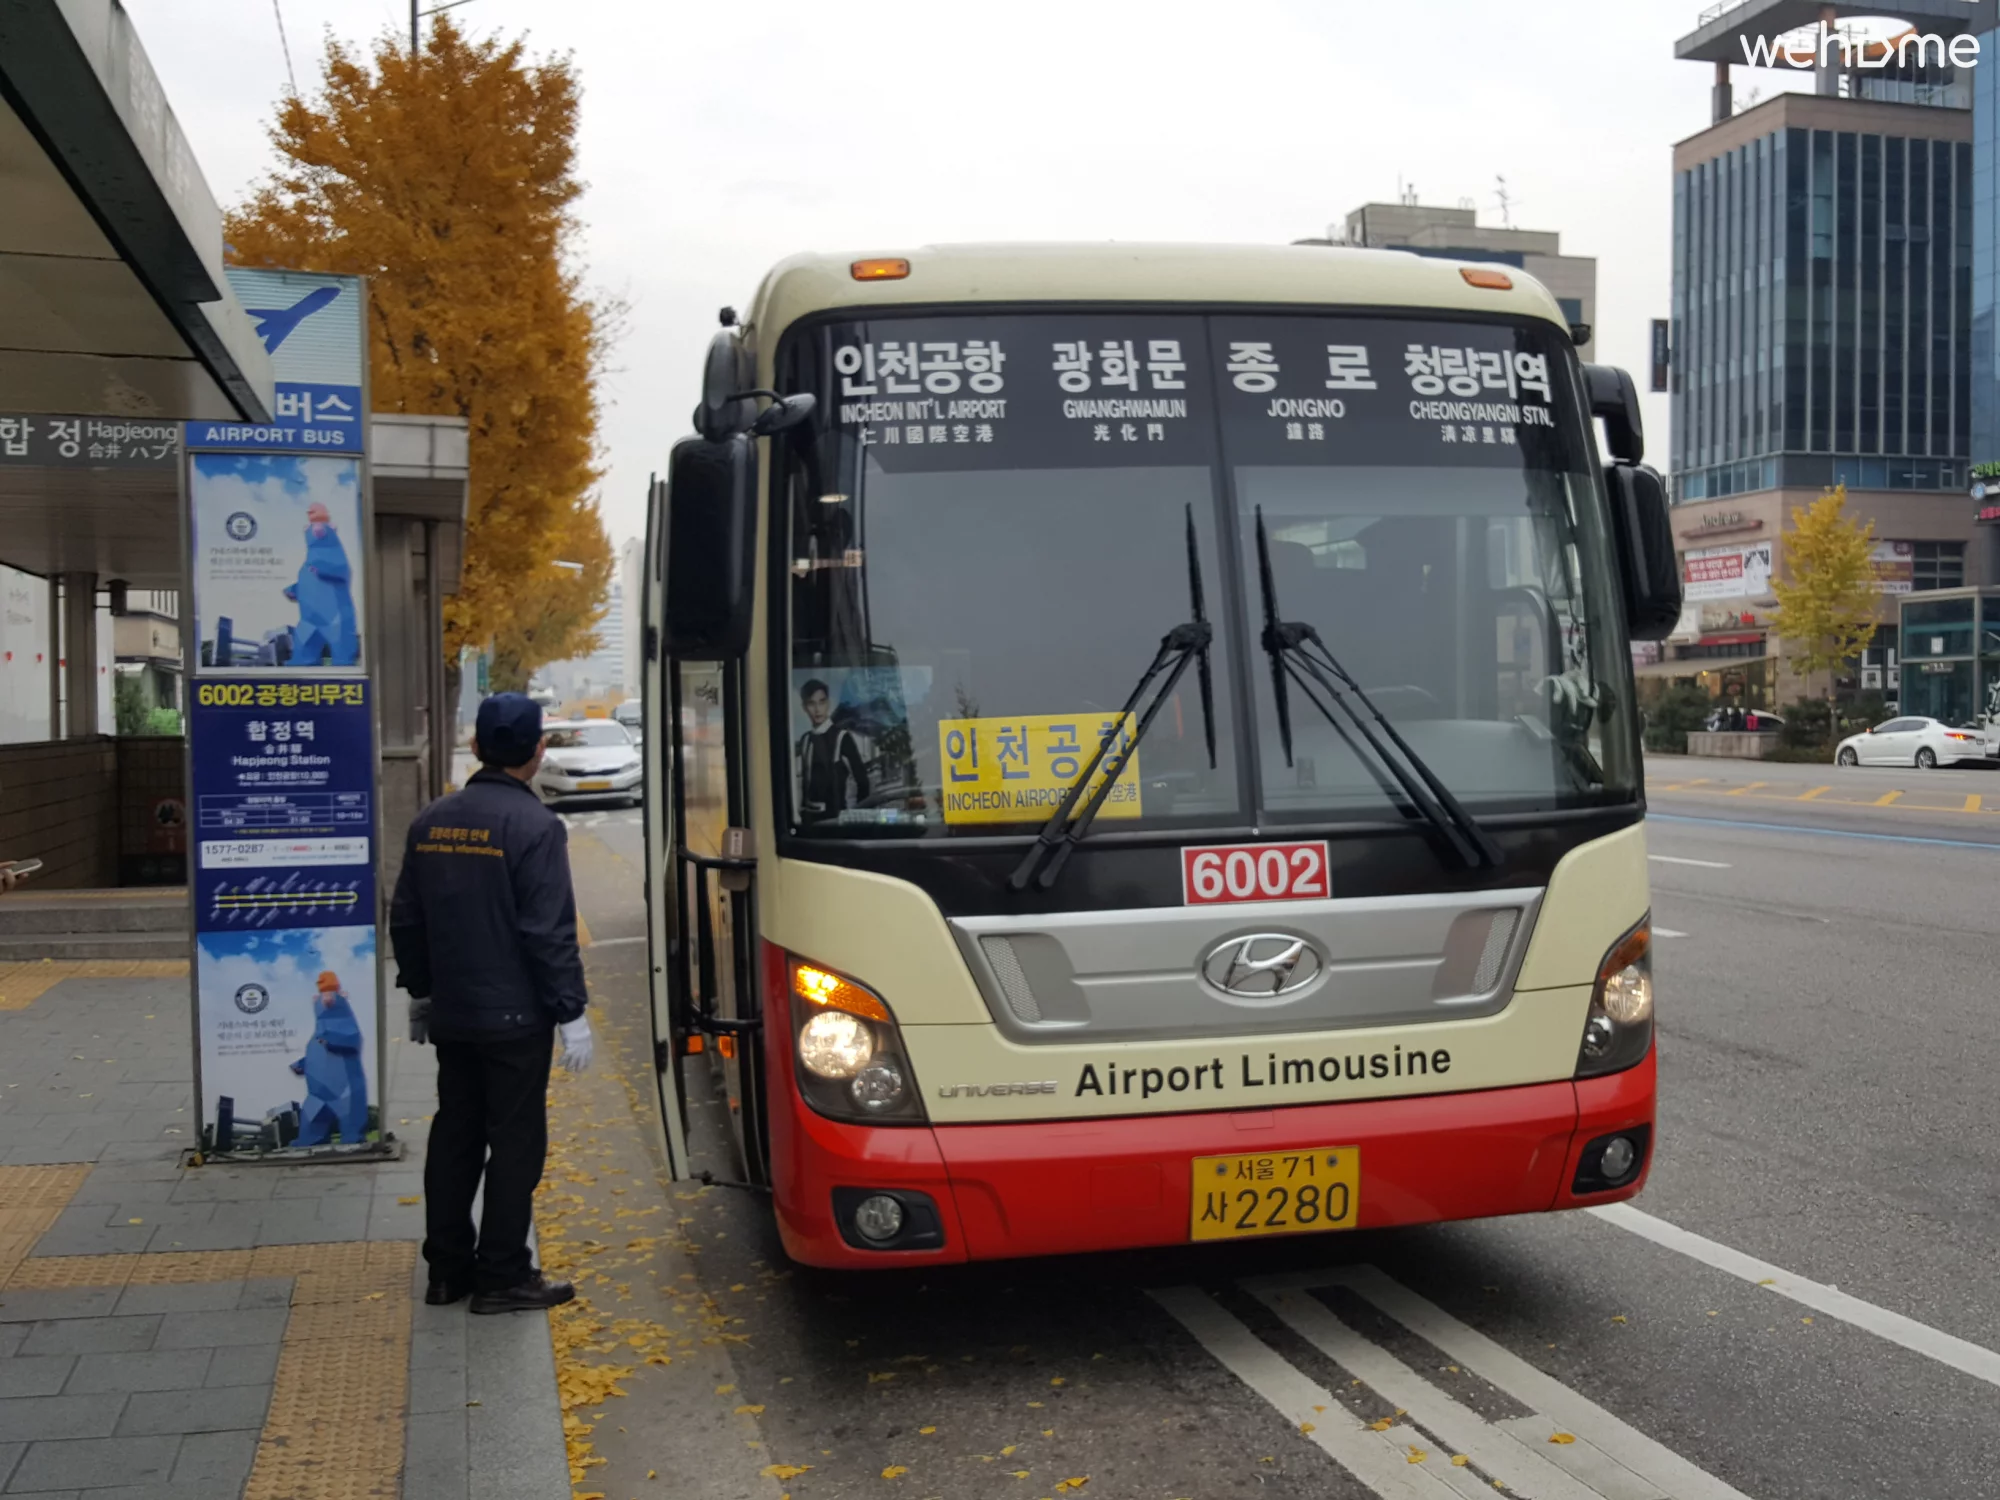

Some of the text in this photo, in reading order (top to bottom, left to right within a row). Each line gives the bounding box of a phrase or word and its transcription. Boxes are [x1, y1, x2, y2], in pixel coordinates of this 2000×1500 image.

[835, 340, 1006, 396] 인천공항
[1053, 340, 1187, 393] 광화문
[1404, 344, 1551, 402] 청량리역
[841, 402, 904, 423] INCHEON
[947, 399, 1007, 419] AIRPORT
[1063, 400, 1187, 419] GWANGHWAMUN
[1267, 398, 1345, 418] JONGNO
[1409, 400, 1554, 428] CHEONGYANGNI STN.
[87, 420, 178, 445] Hapjeong
[206, 427, 345, 445] AIRPORT BUS
[1094, 423, 1164, 441] 光化門
[88, 442, 122, 459] 合井
[948, 790, 1013, 811] INCHEON
[1192, 848, 1322, 898] 6002
[1074, 1045, 1452, 1099] Airport Limousine
[938, 1080, 1058, 1098] UNIVERSE
[1235, 1155, 1315, 1181] 서울 71
